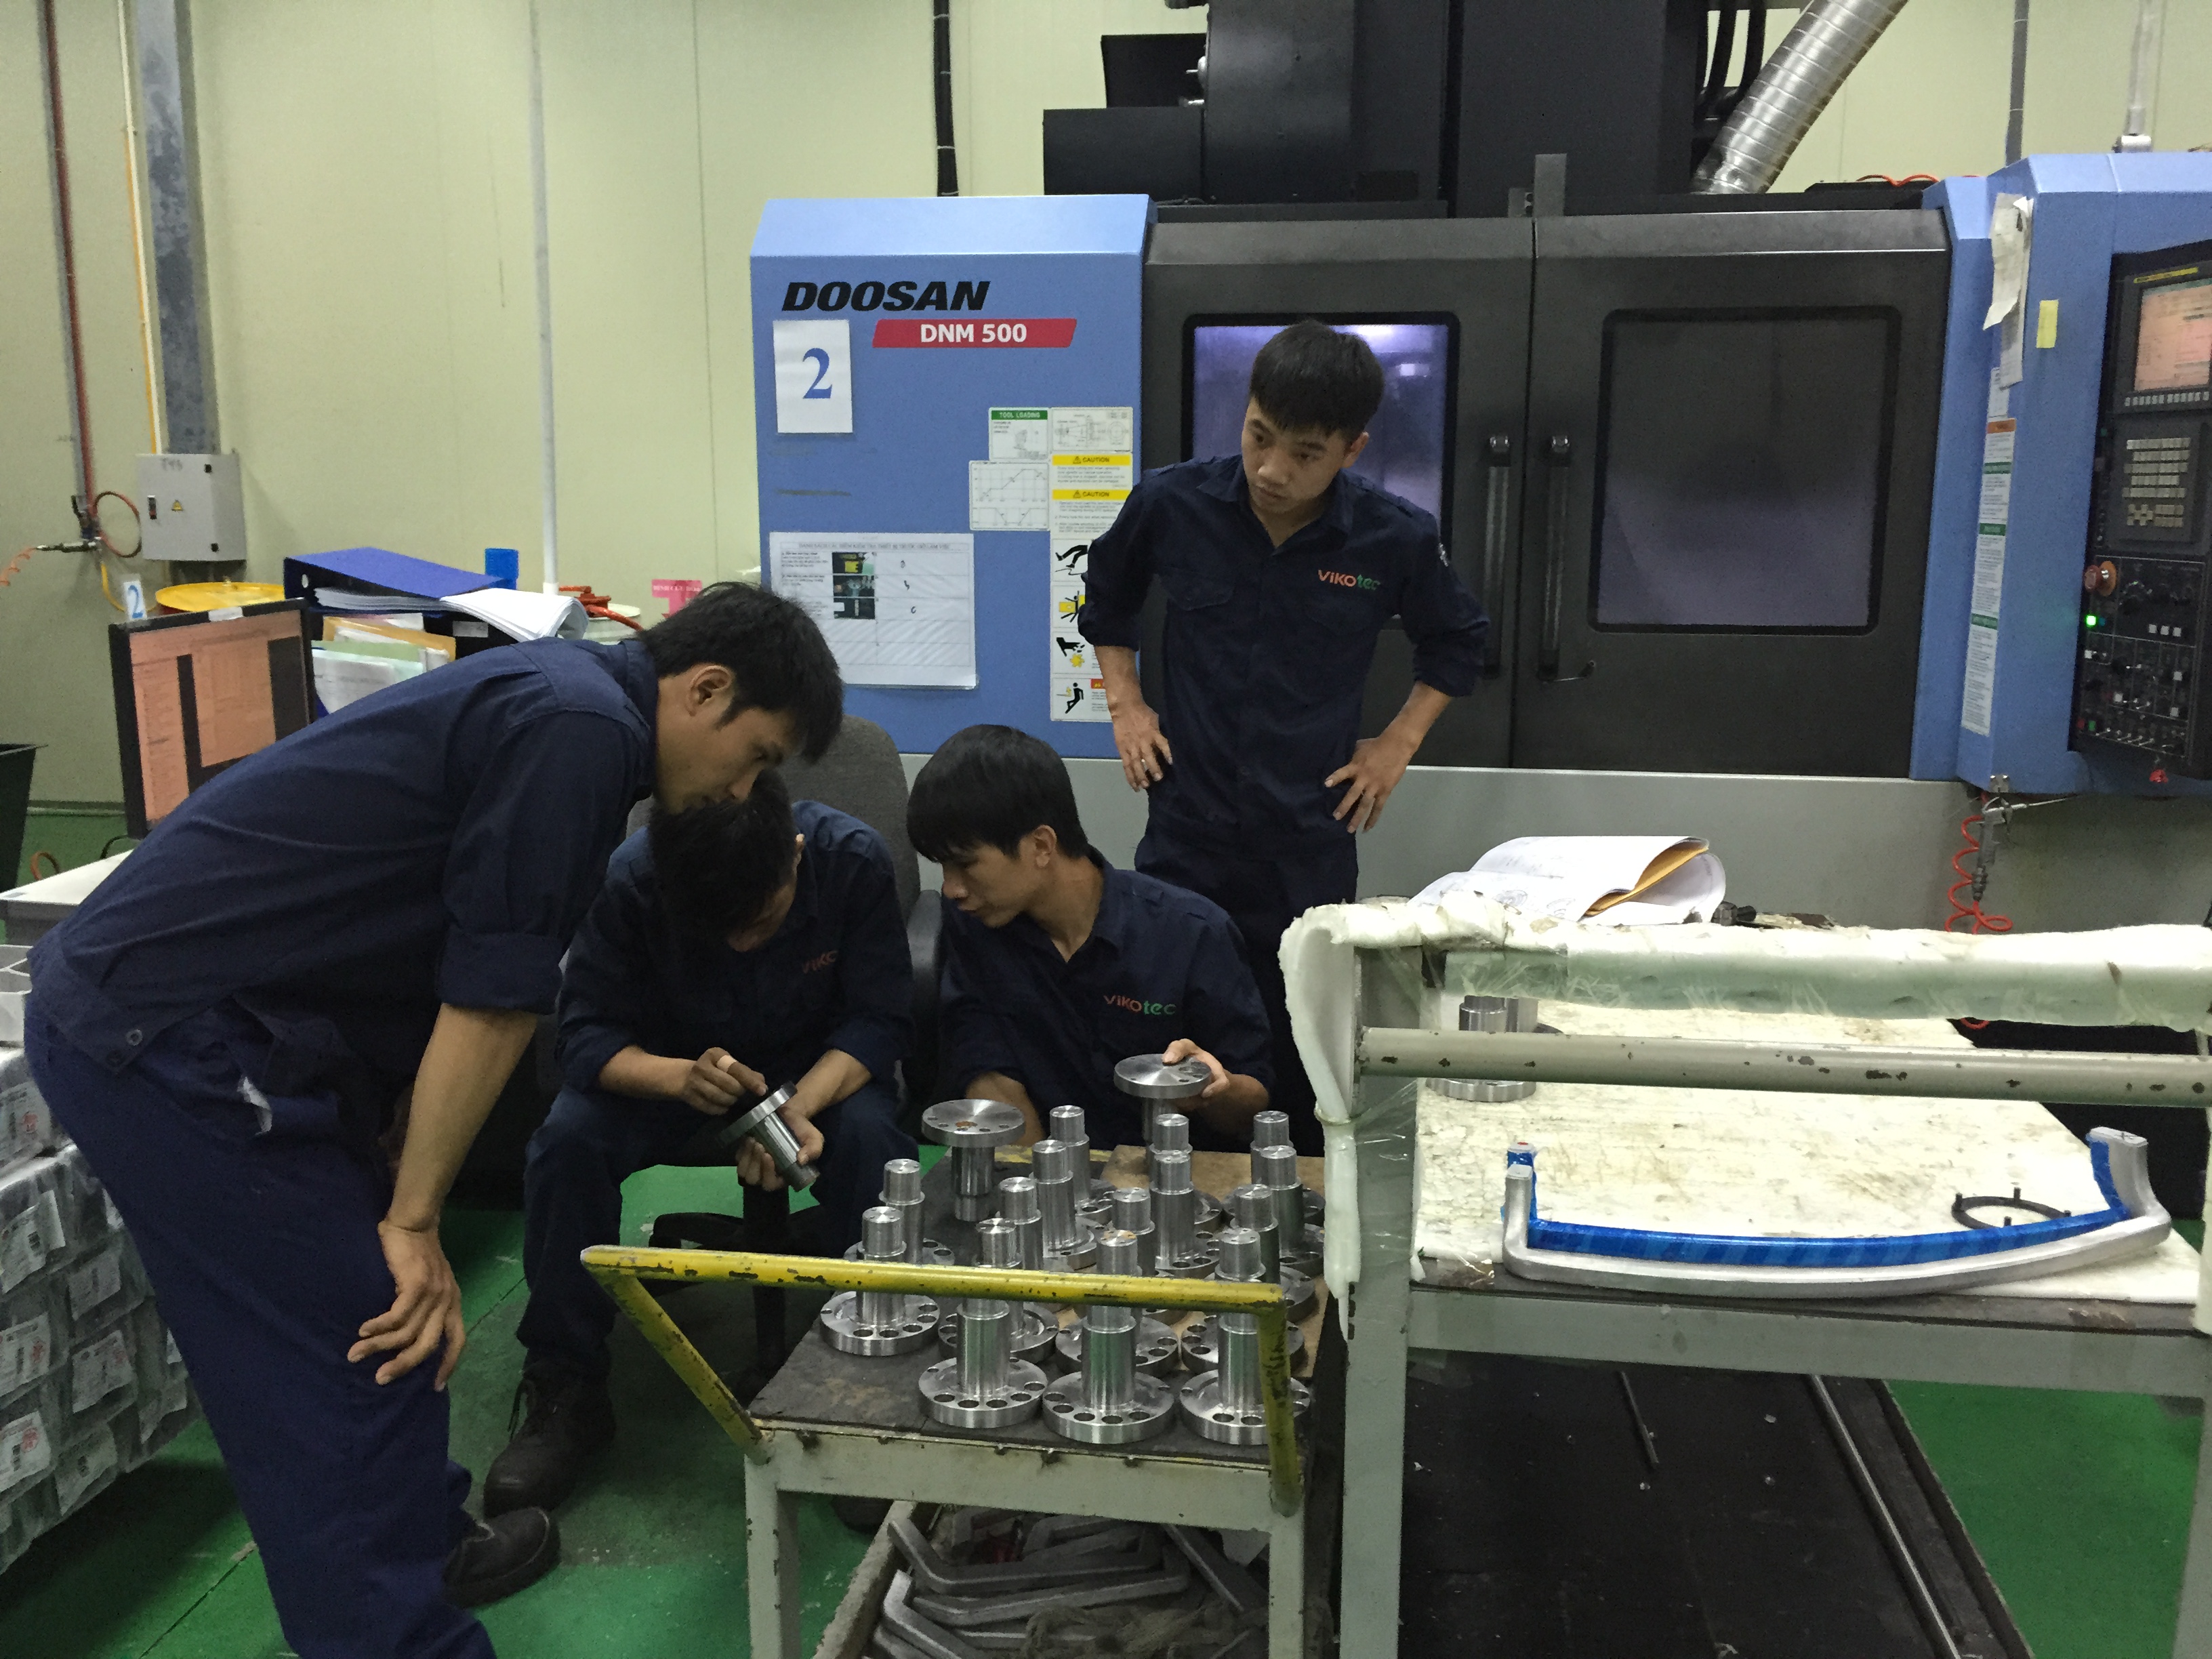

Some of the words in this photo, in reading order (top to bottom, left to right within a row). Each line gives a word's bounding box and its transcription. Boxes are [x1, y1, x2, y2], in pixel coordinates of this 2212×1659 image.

[781, 281, 990, 311] DOOSAN
[920, 324, 975, 343] DNM
[981, 323, 1027, 343] 500
[802, 347, 834, 400] 2
[128, 585, 144, 618] 2
